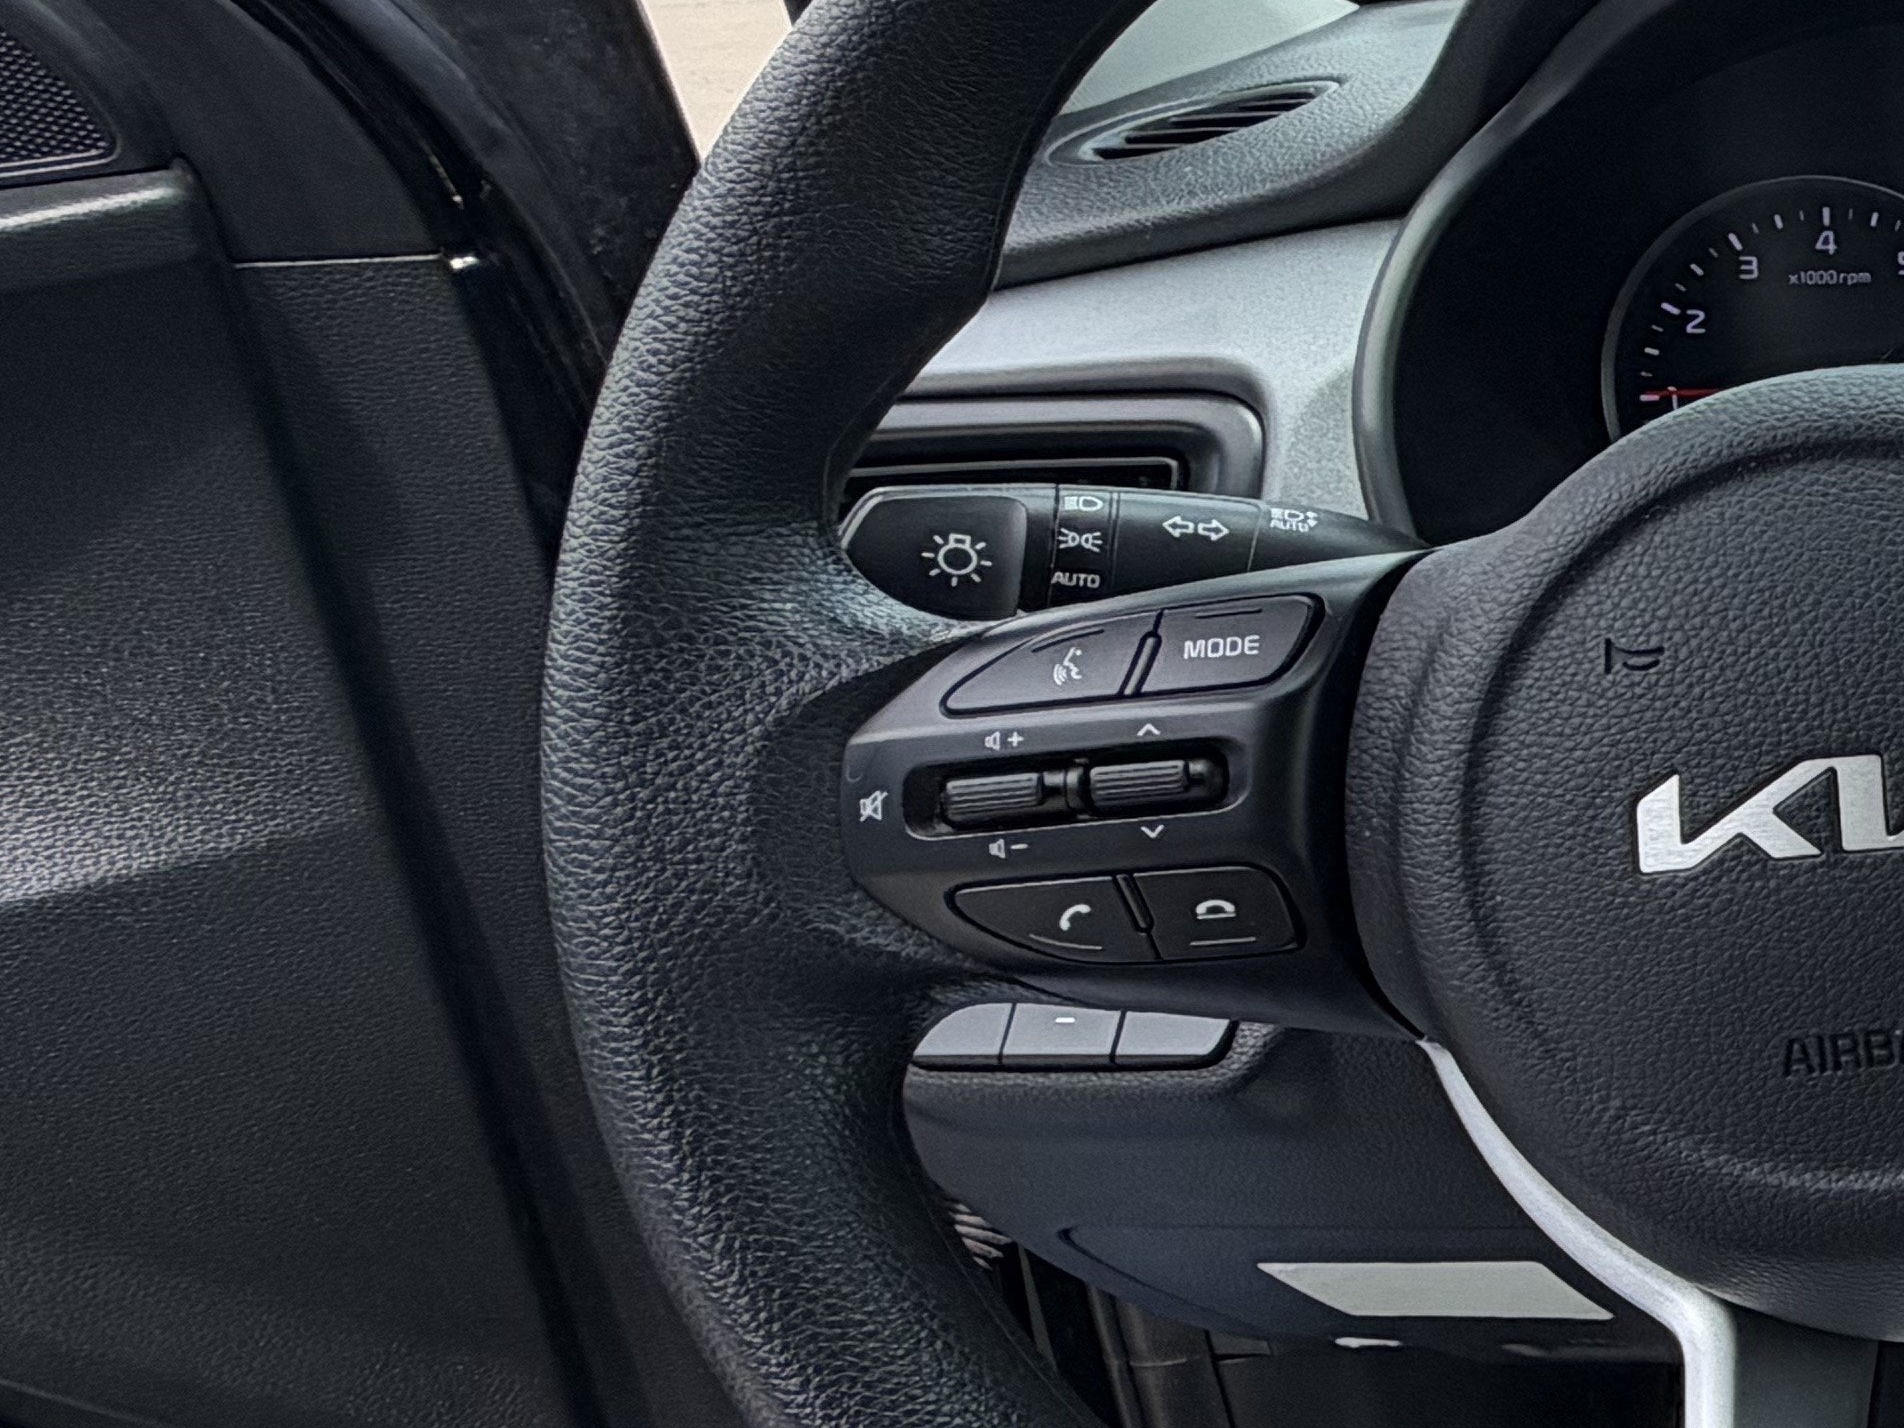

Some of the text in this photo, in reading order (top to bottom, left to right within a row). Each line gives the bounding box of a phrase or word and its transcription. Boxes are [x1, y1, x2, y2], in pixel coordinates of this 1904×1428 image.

[1815, 229, 1837, 256] 4
[1739, 255, 1759, 280] 3
[1685, 309, 1706, 335] 2
[1270, 520, 1310, 533] AUTO
[1050, 571, 1101, 589] AUTO
[1183, 633, 1261, 661] MODE
